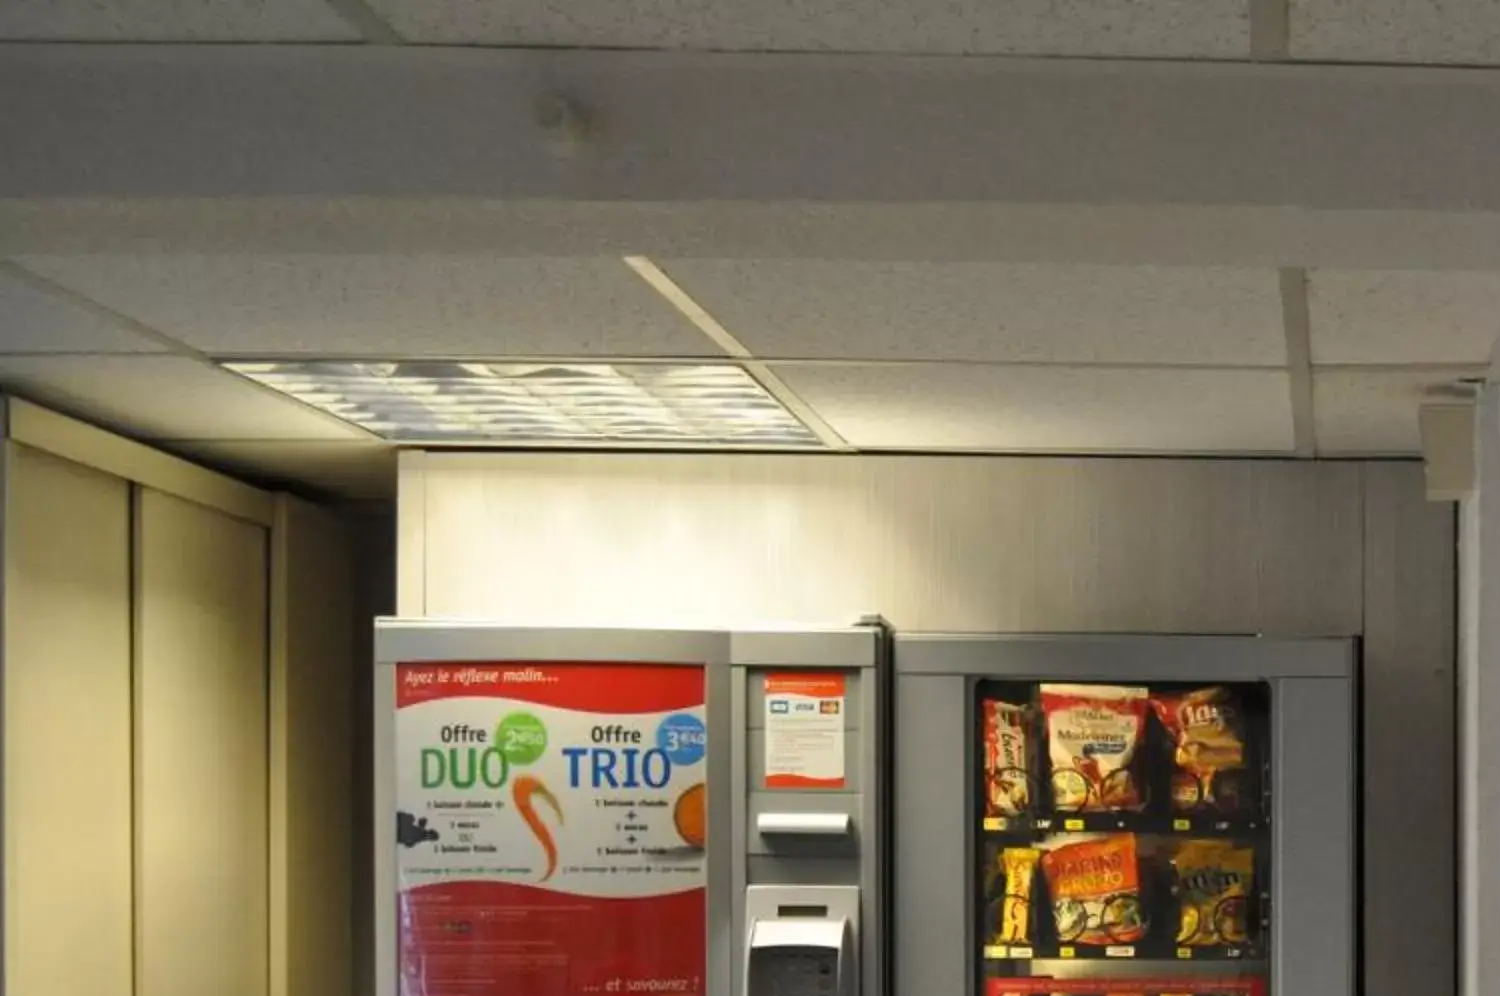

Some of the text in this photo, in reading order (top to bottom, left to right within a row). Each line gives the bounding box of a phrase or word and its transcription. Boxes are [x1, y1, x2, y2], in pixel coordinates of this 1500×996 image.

[405, 670, 432, 686] Ayez
[437, 669, 448, 682] le
[453, 667, 498, 685] réflexe
[440, 725, 487, 744] Offre
[592, 725, 641, 744] Offre
[420, 748, 509, 789] DUO
[562, 748, 671, 789] TRIO
[606, 976, 622, 992] et
